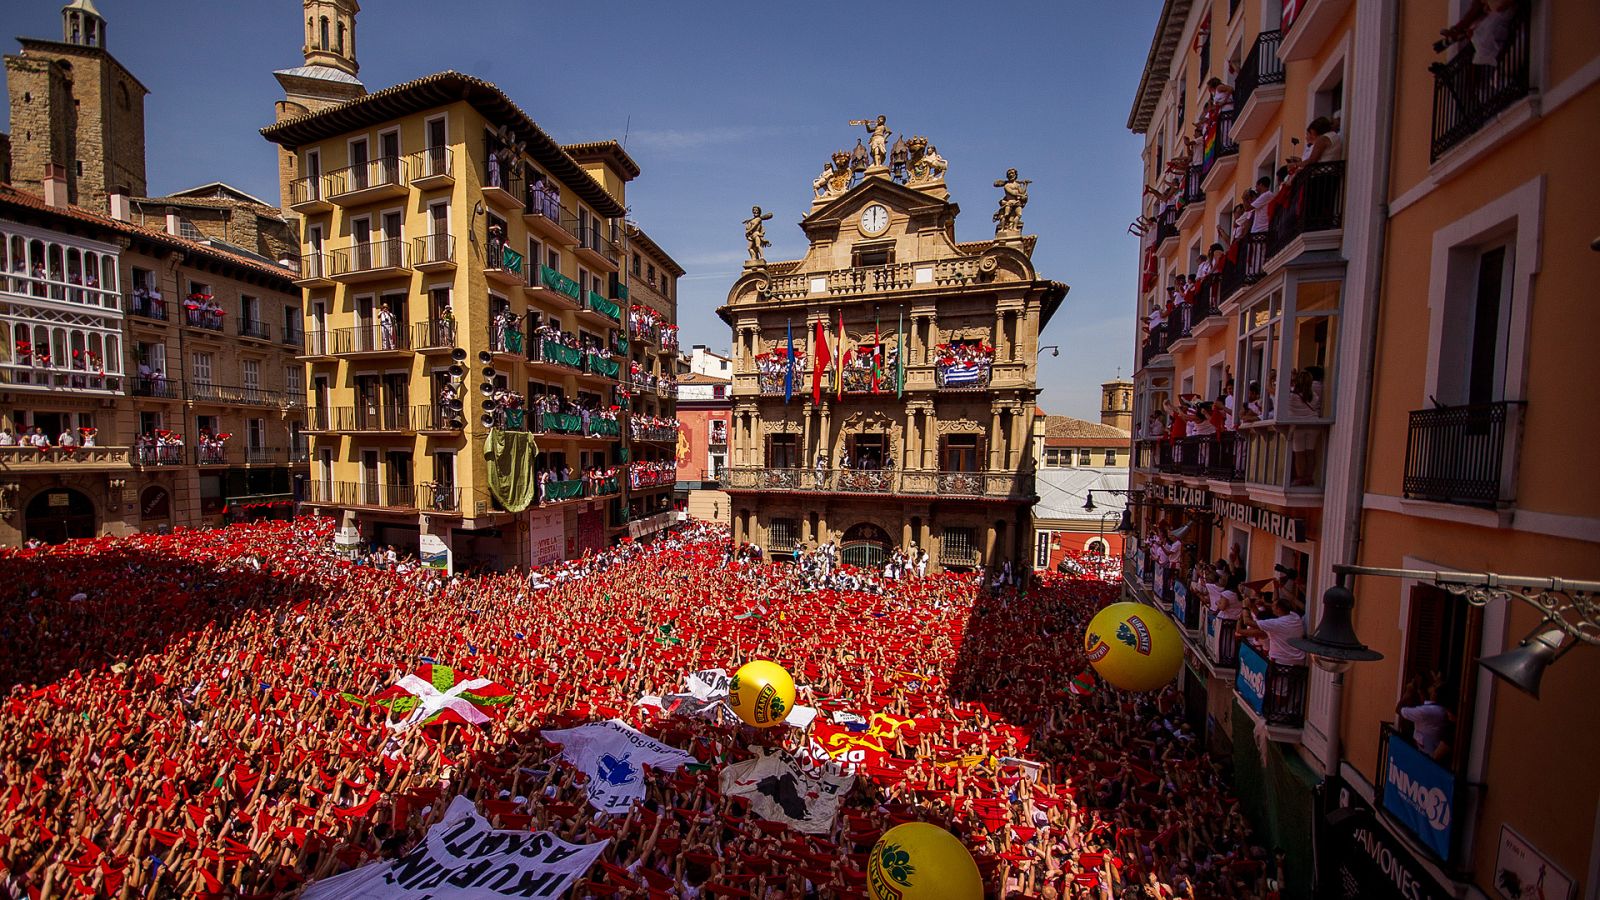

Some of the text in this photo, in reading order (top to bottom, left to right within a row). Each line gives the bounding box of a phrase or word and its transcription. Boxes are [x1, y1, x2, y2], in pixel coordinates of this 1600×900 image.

[1168, 485, 1206, 506] ELIZARI
[1212, 498, 1296, 542] INMOBILIARIA
[1131, 617, 1149, 652] URZANTE
[757, 687, 773, 722] URZANTE
[439, 816, 583, 863] ASKATU
[1353, 828, 1421, 900] JAMONES
